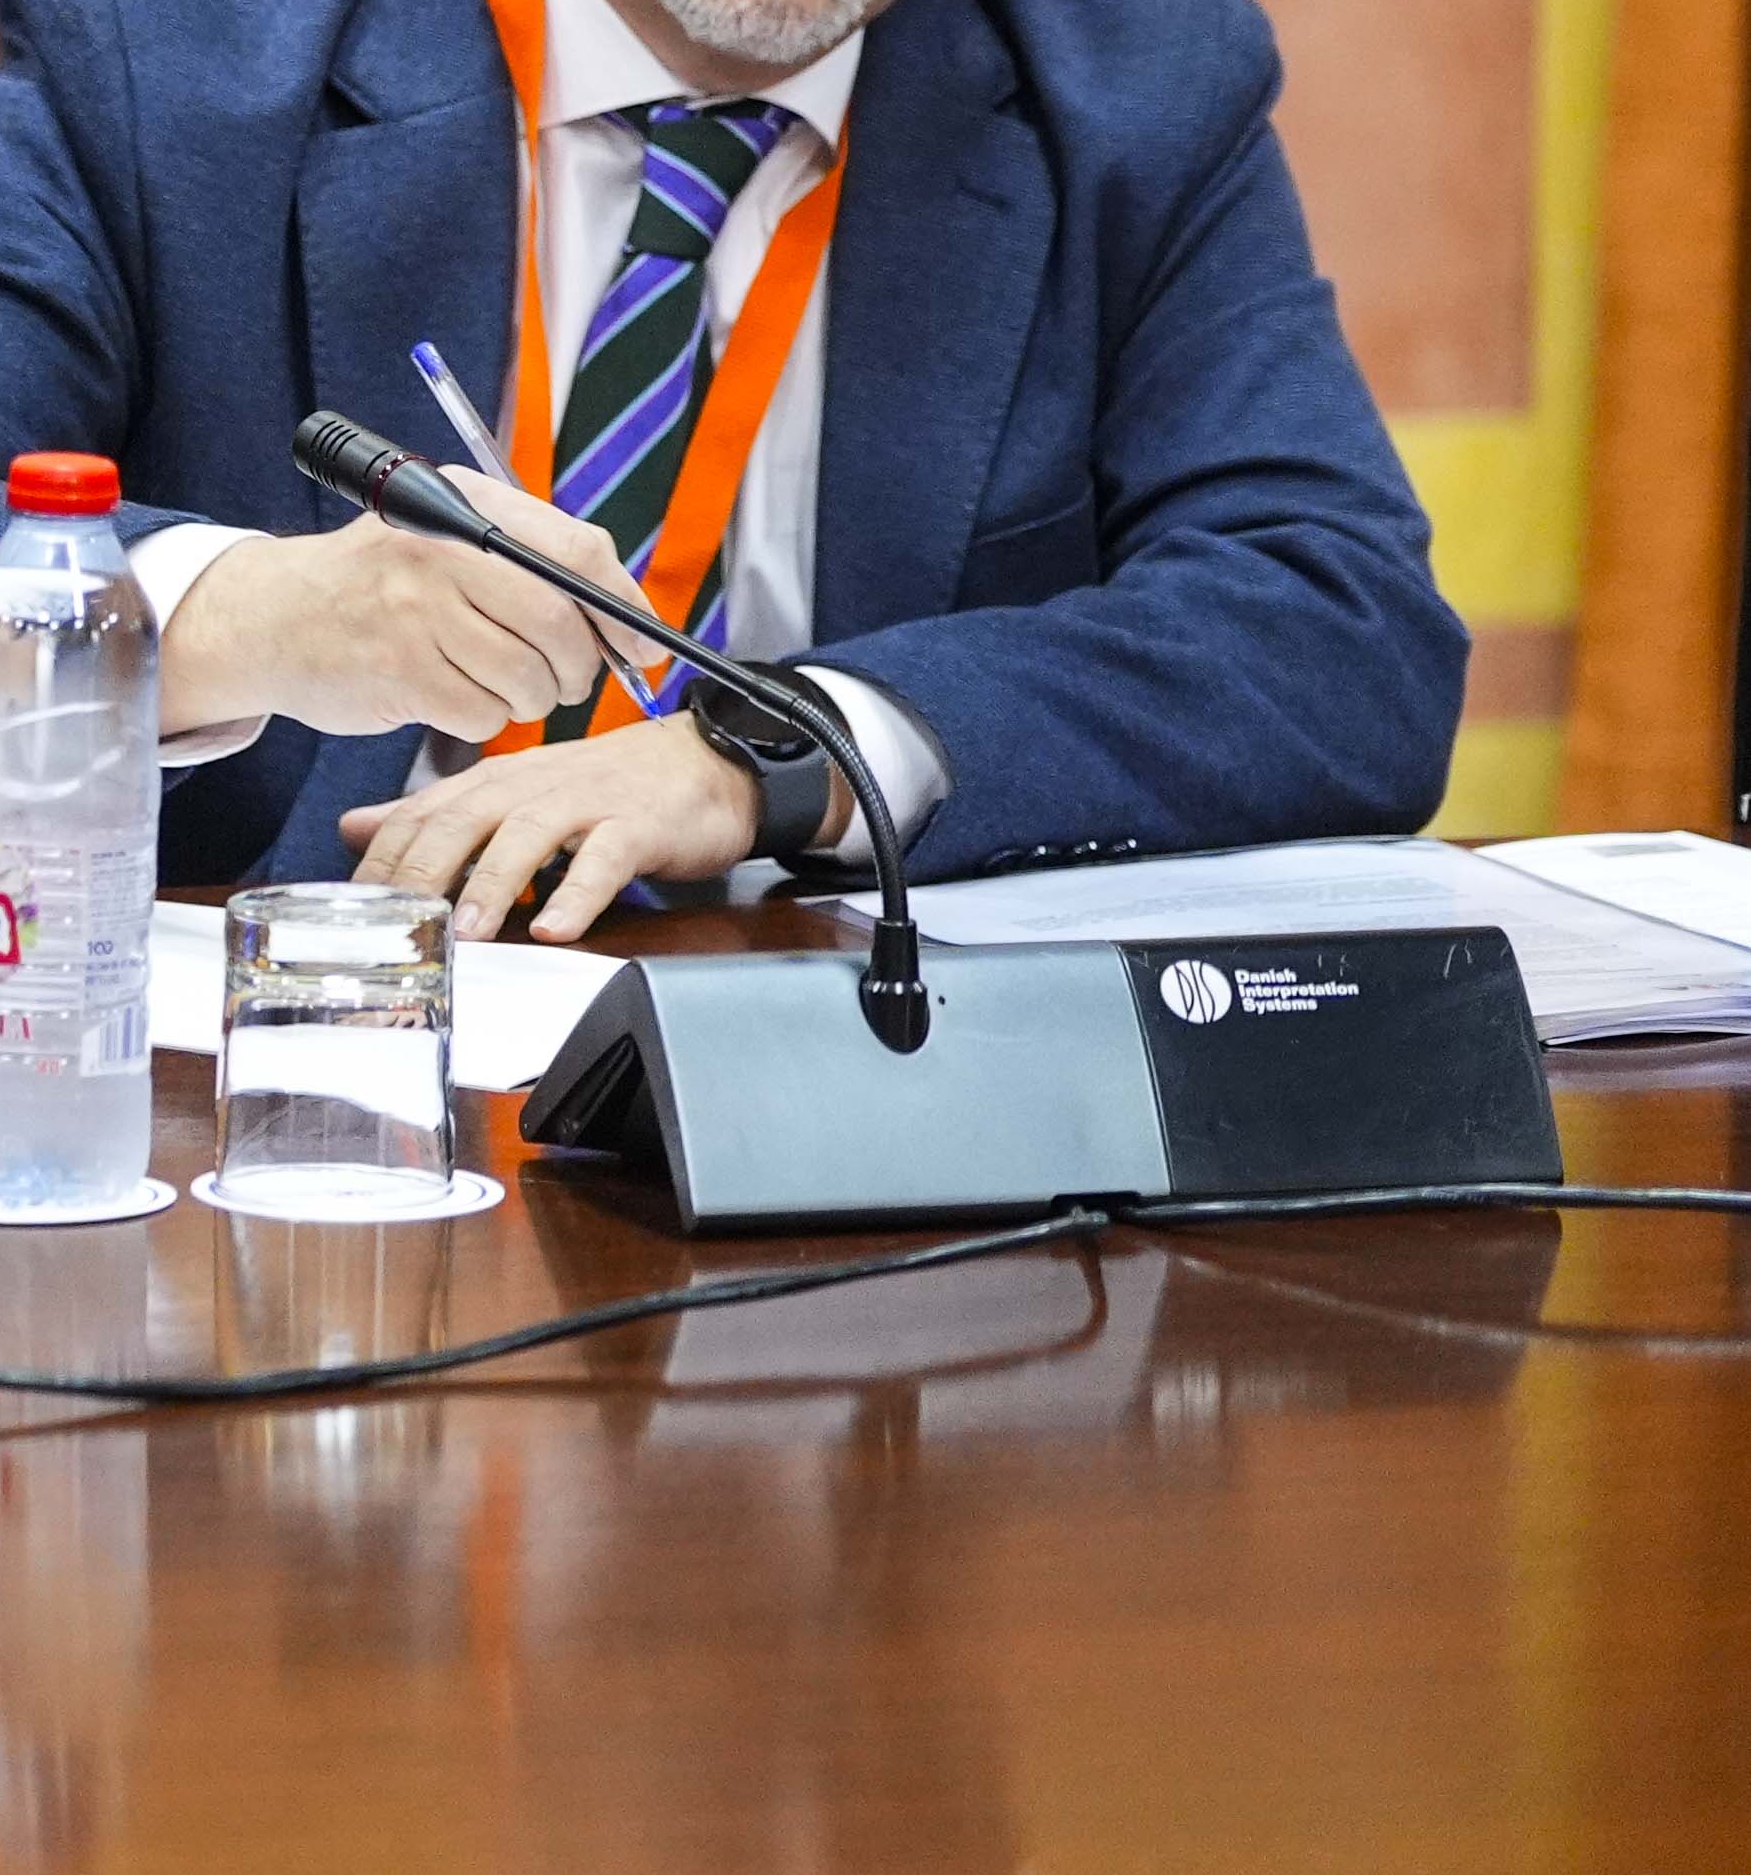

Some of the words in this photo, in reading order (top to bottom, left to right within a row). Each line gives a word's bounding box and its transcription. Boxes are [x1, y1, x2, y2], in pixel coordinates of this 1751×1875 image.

[1234, 968, 1297, 984] Danish
[1238, 981, 1360, 1000] Interpretation
[1242, 997, 1318, 1016] Systems
